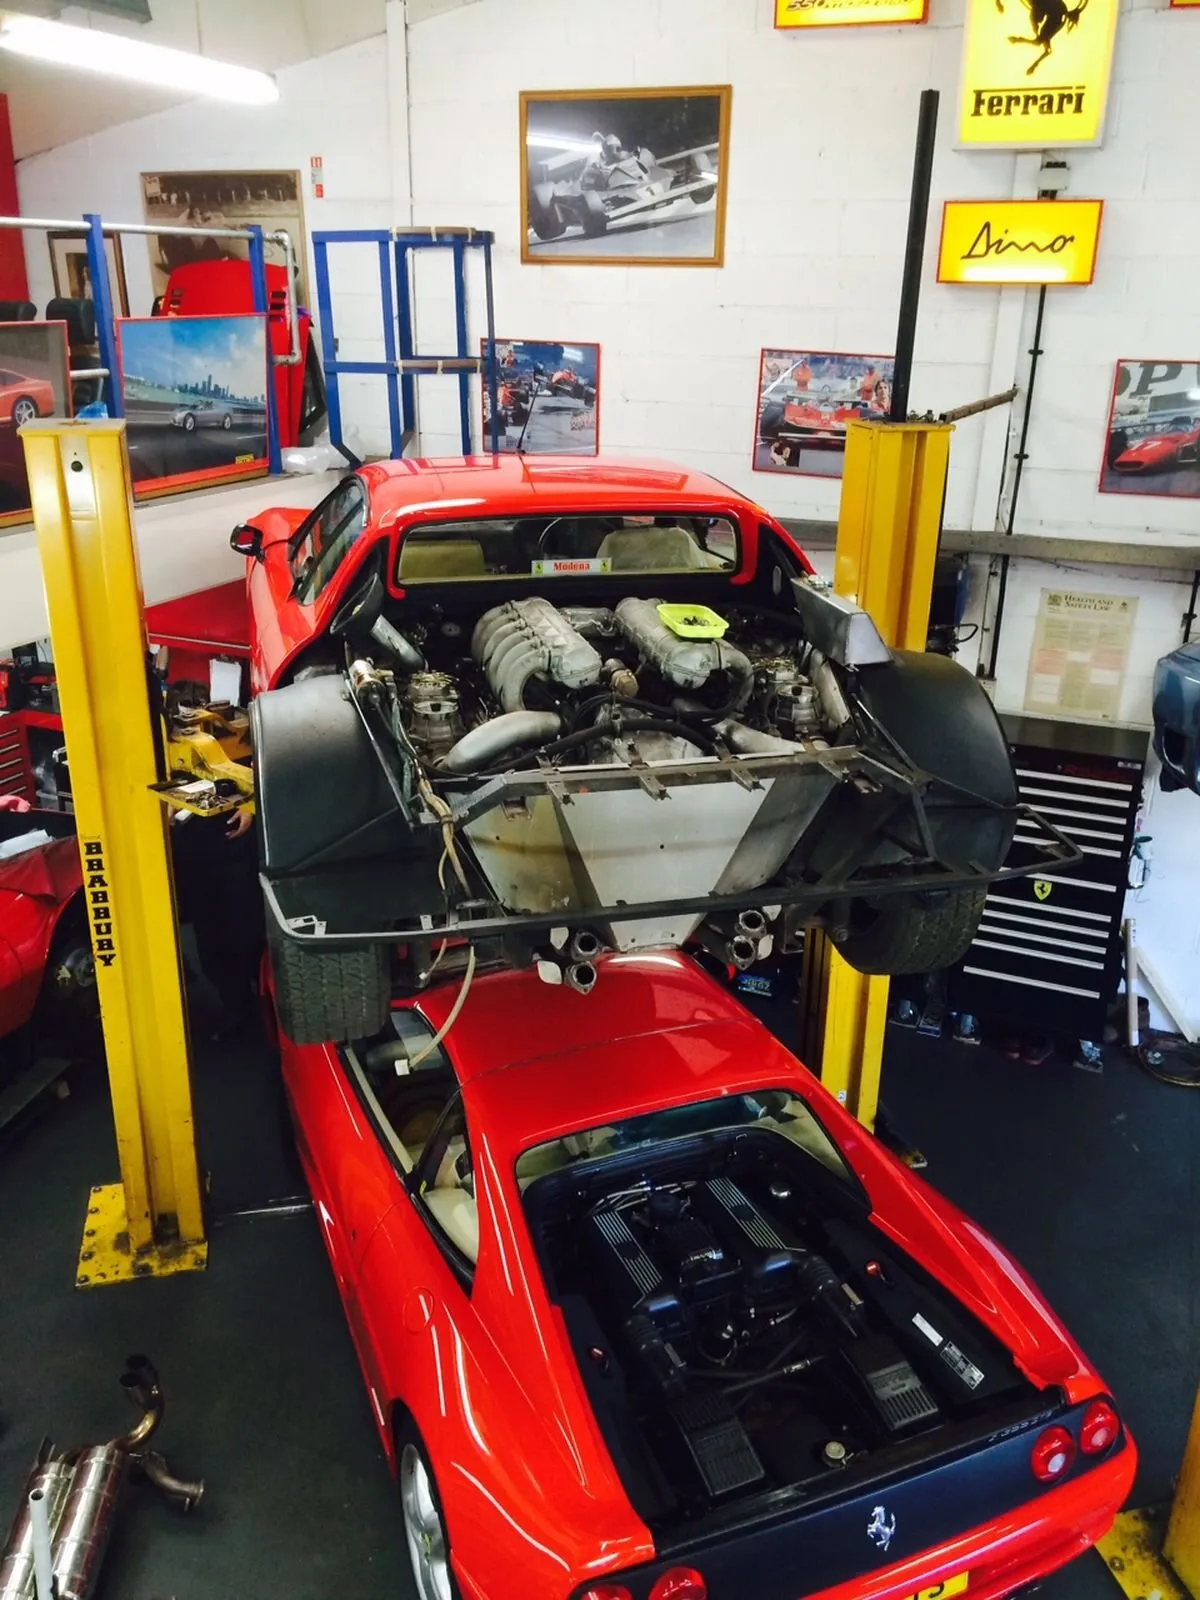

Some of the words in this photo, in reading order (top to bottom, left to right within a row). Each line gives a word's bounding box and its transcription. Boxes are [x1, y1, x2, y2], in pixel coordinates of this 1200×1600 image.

[971, 86, 1086, 117] Ferrari
[960, 221, 1075, 260] Dino
[553, 561, 591, 571] Modena
